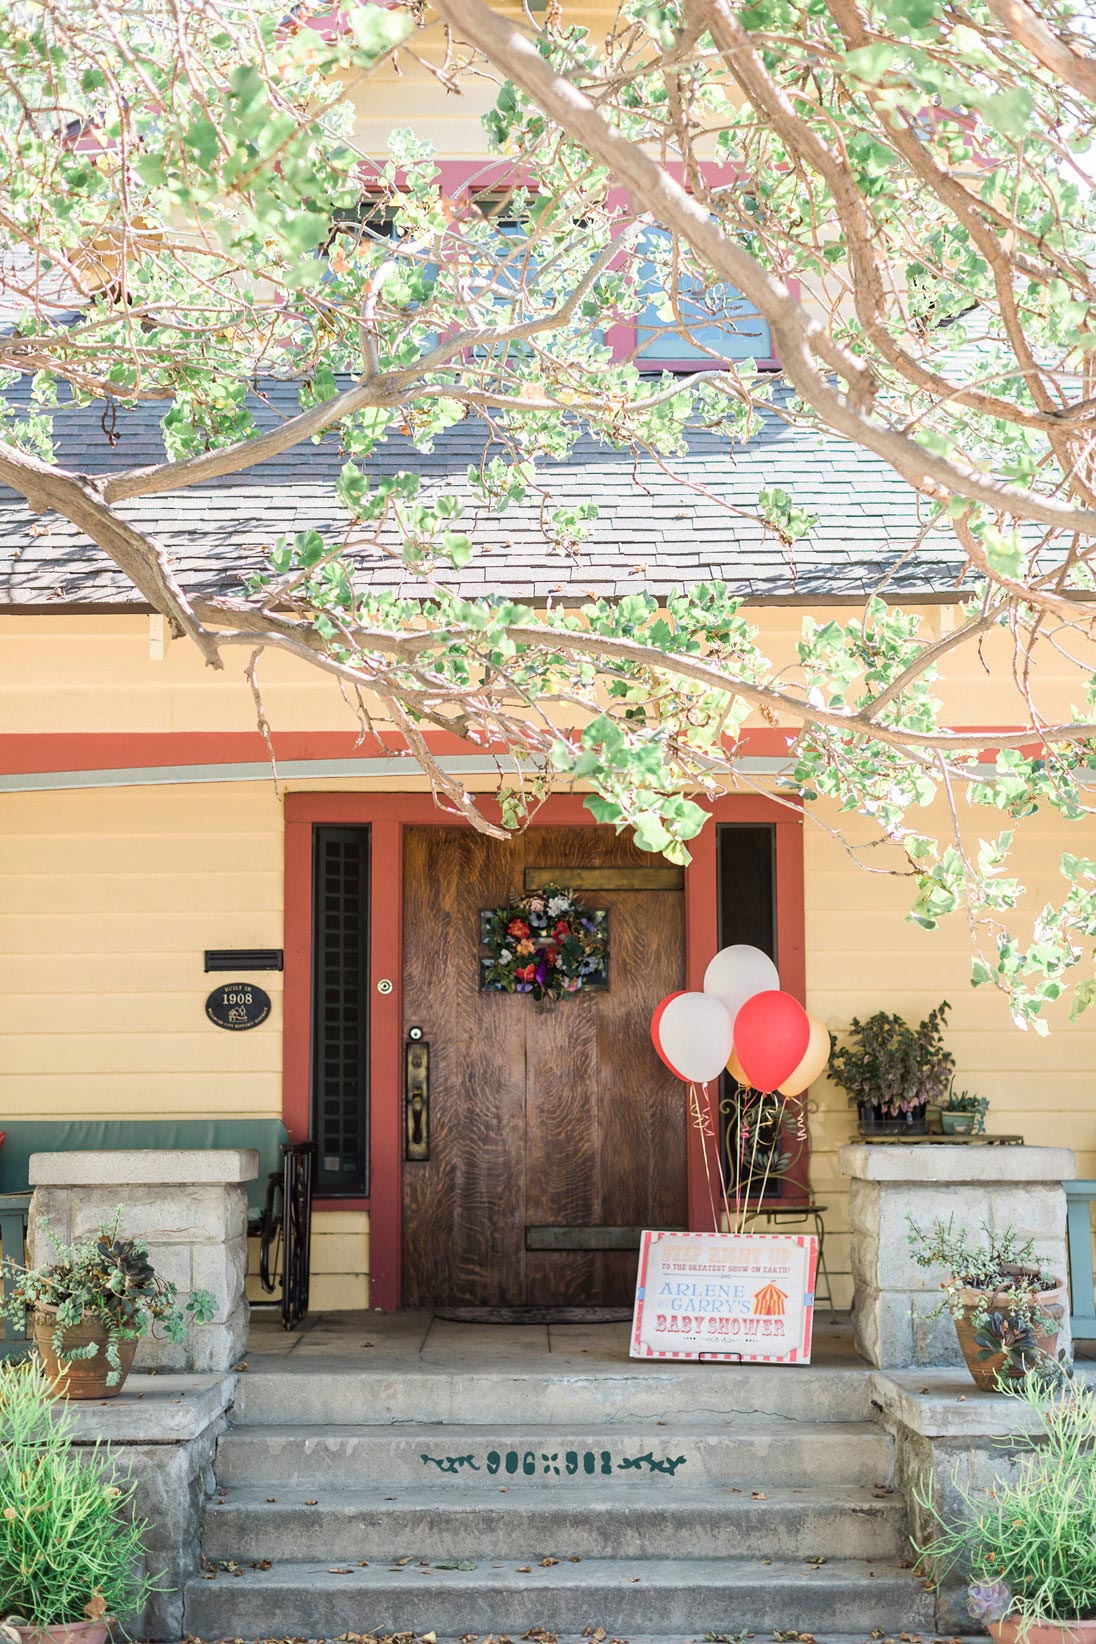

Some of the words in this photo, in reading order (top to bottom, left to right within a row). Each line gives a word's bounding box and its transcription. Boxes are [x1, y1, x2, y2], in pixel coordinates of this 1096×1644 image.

[222, 993, 253, 1005] 1908
[662, 1245, 702, 1262] STEP
[708, 1246, 762, 1264] RIGHT
[769, 1248, 792, 1265] UP
[673, 1263, 687, 1271] THE
[688, 1264, 726, 1272] GREATEST
[763, 1266, 791, 1274] EARTH!
[660, 1282, 745, 1298] ARLENE
[671, 1298, 751, 1314] GARRY'S
[655, 1314, 705, 1334] BABY
[707, 1316, 785, 1337] SHOWER
[487, 1451, 535, 1475] 906
